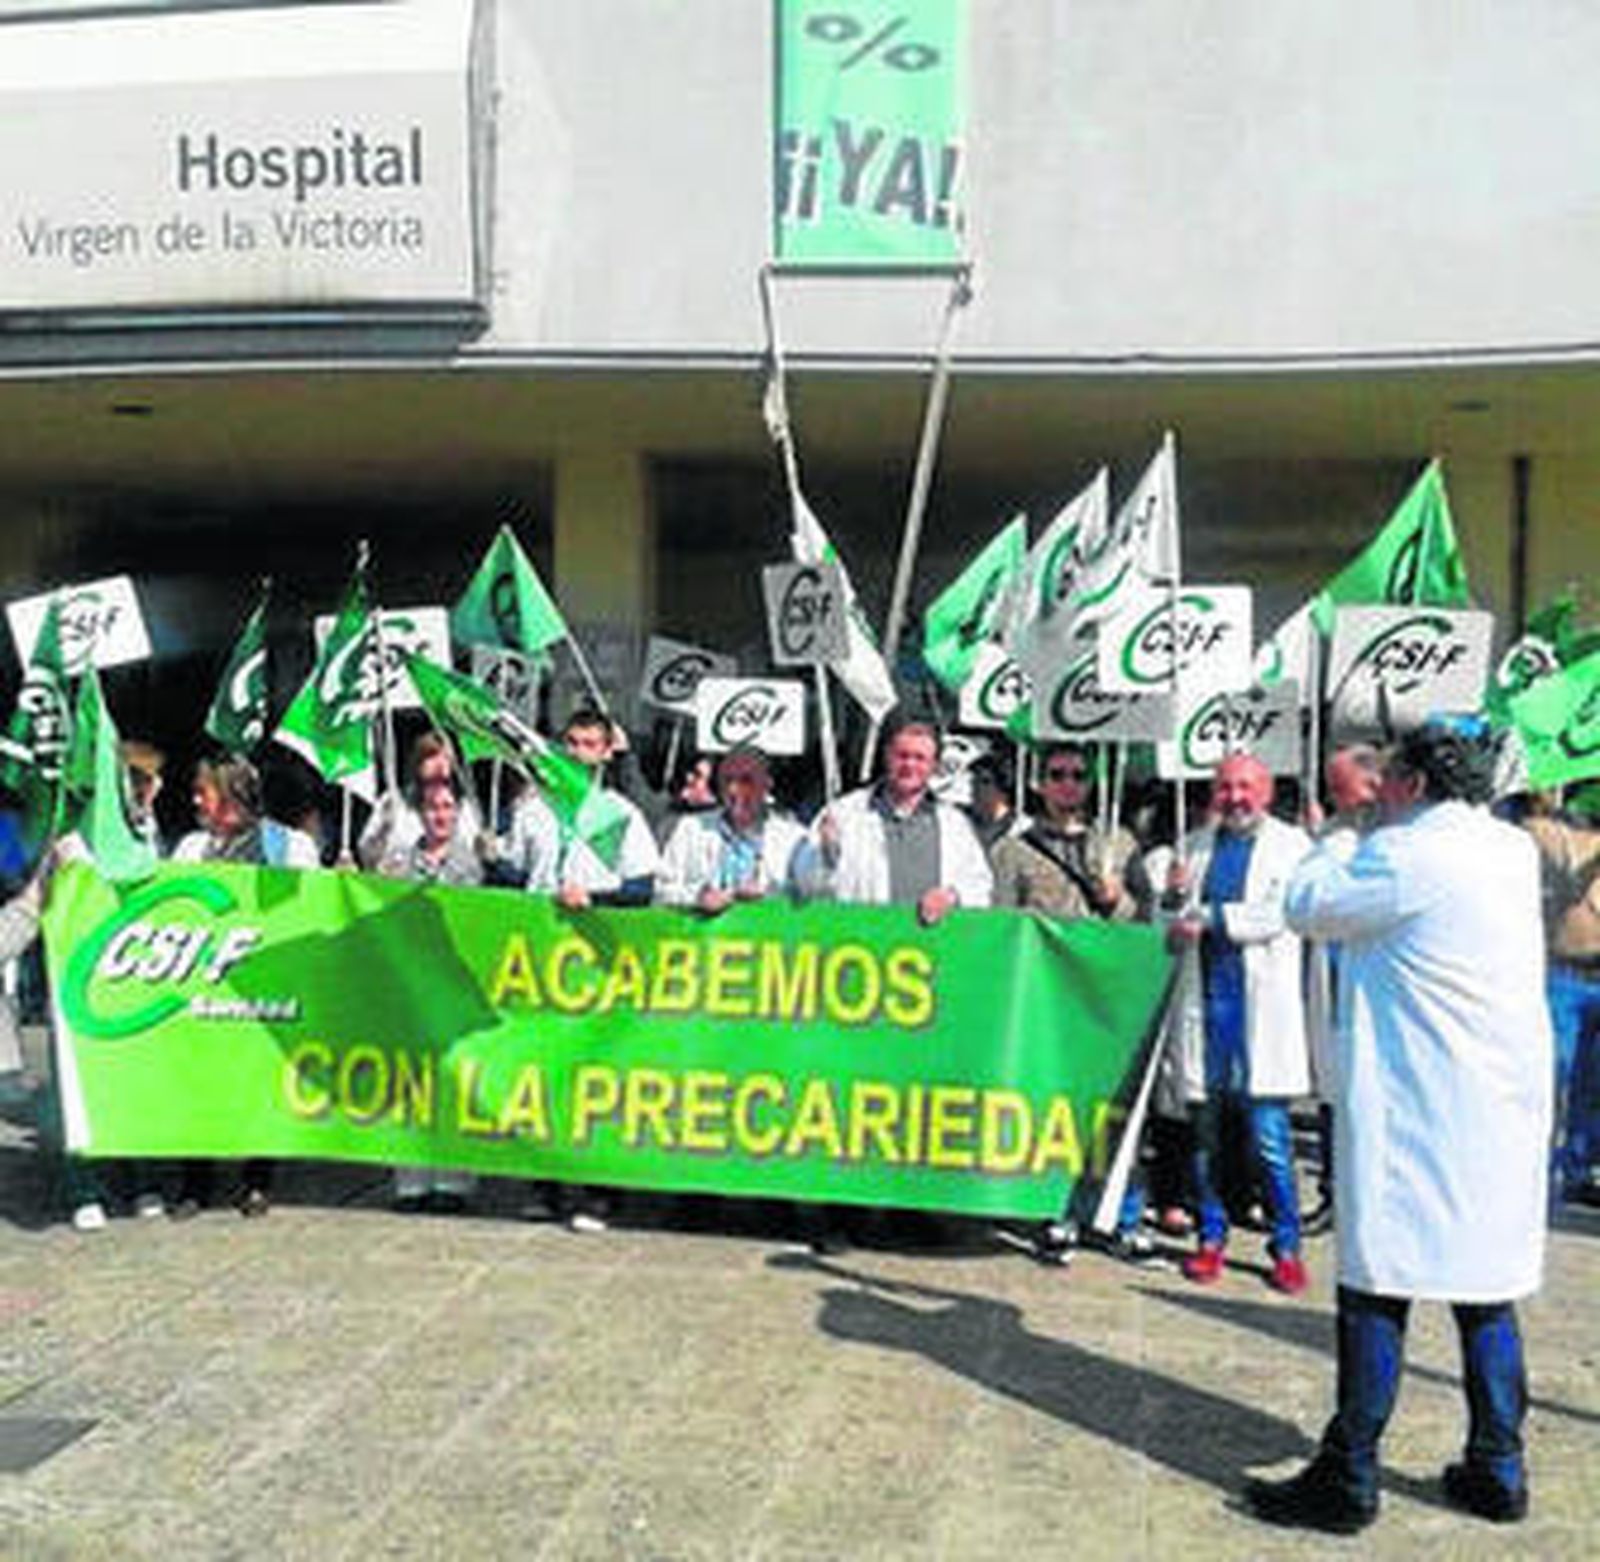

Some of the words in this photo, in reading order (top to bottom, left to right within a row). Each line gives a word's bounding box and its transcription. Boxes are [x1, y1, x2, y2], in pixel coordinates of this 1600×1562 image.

[177, 128, 423, 202] Hospital
[18, 220, 140, 266] Virgen
[156, 214, 205, 252] de
[222, 210, 256, 250] la
[271, 209, 423, 249] Victoria
[490, 931, 935, 1026] ACABEMOS
[280, 1040, 434, 1127] CON
[453, 1060, 551, 1142] LA
